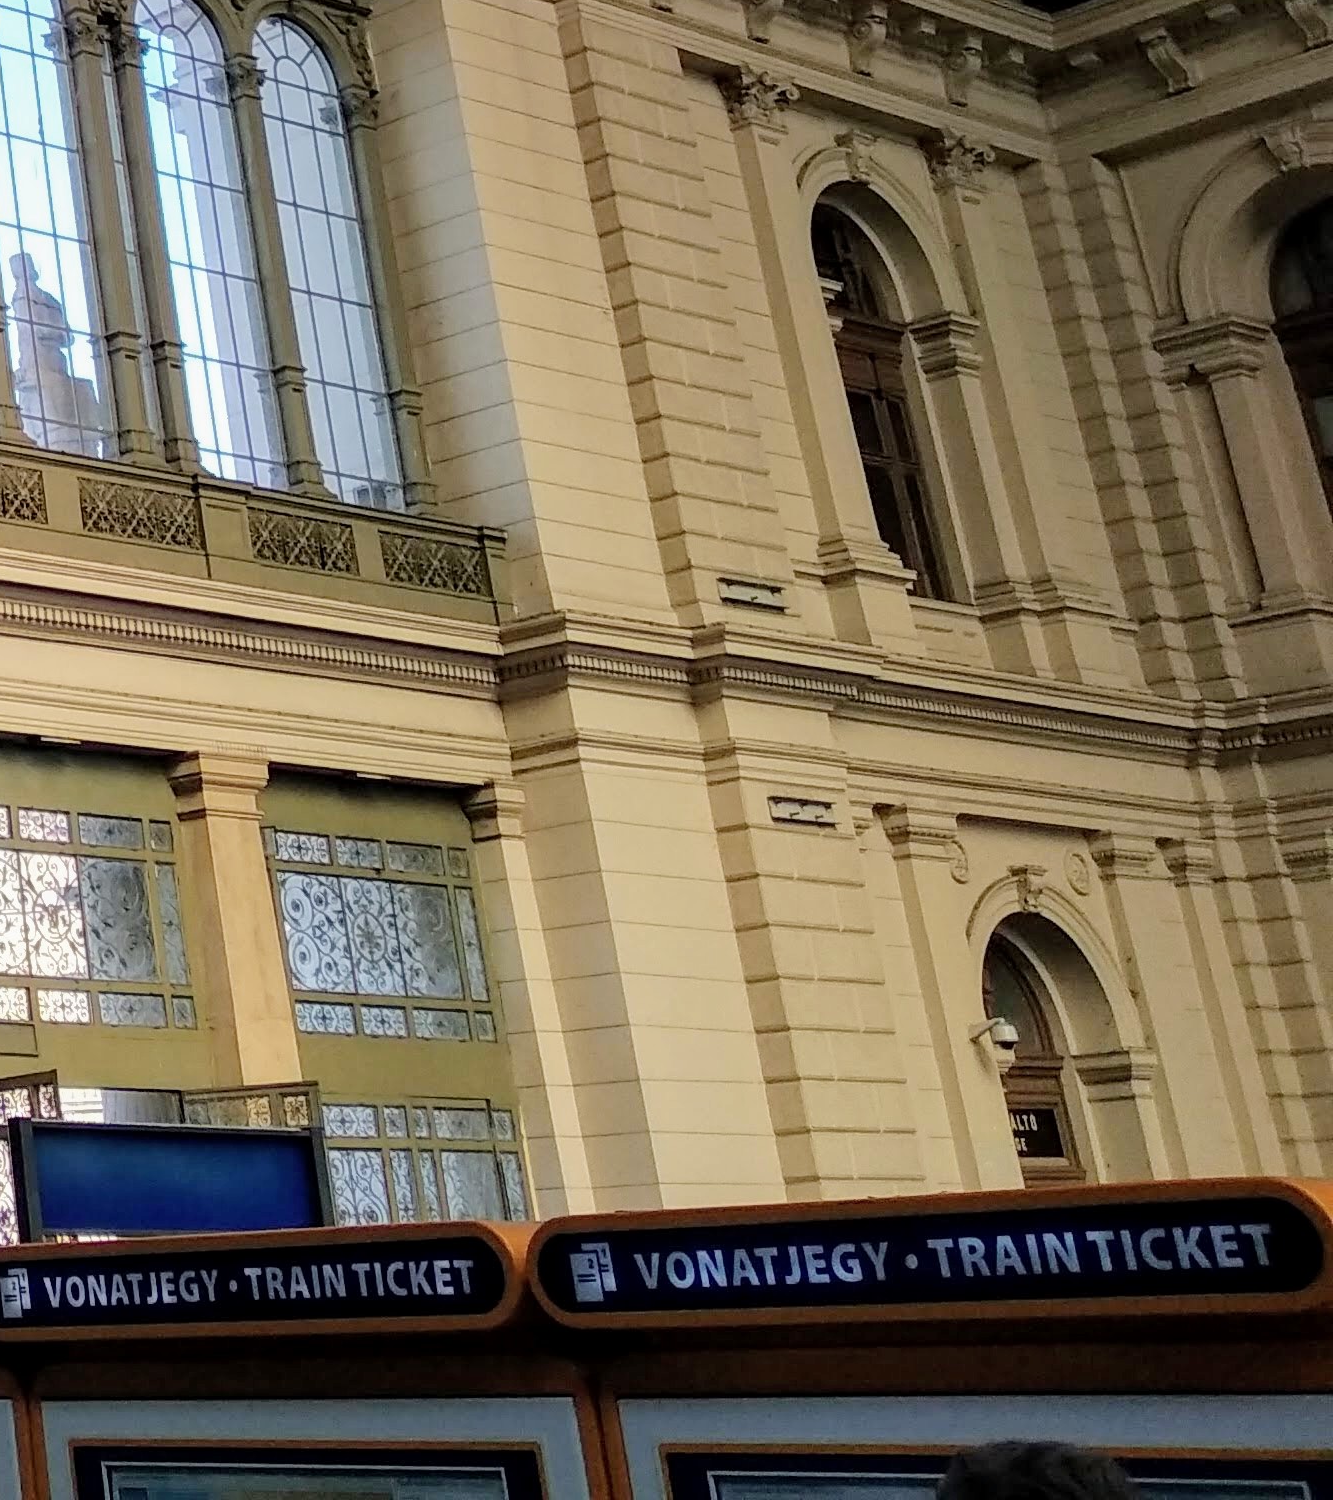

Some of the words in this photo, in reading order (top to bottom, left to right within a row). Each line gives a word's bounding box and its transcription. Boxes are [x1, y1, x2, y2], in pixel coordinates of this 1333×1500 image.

[43, 1269, 219, 1309] VONATJEGY
[244, 1263, 347, 1301] TRAIN
[351, 1259, 475, 1298] TICKET
[633, 1241, 889, 1290] VONATJEGY
[926, 1231, 1082, 1278] TRAIN
[1085, 1223, 1272, 1273] TICKET
